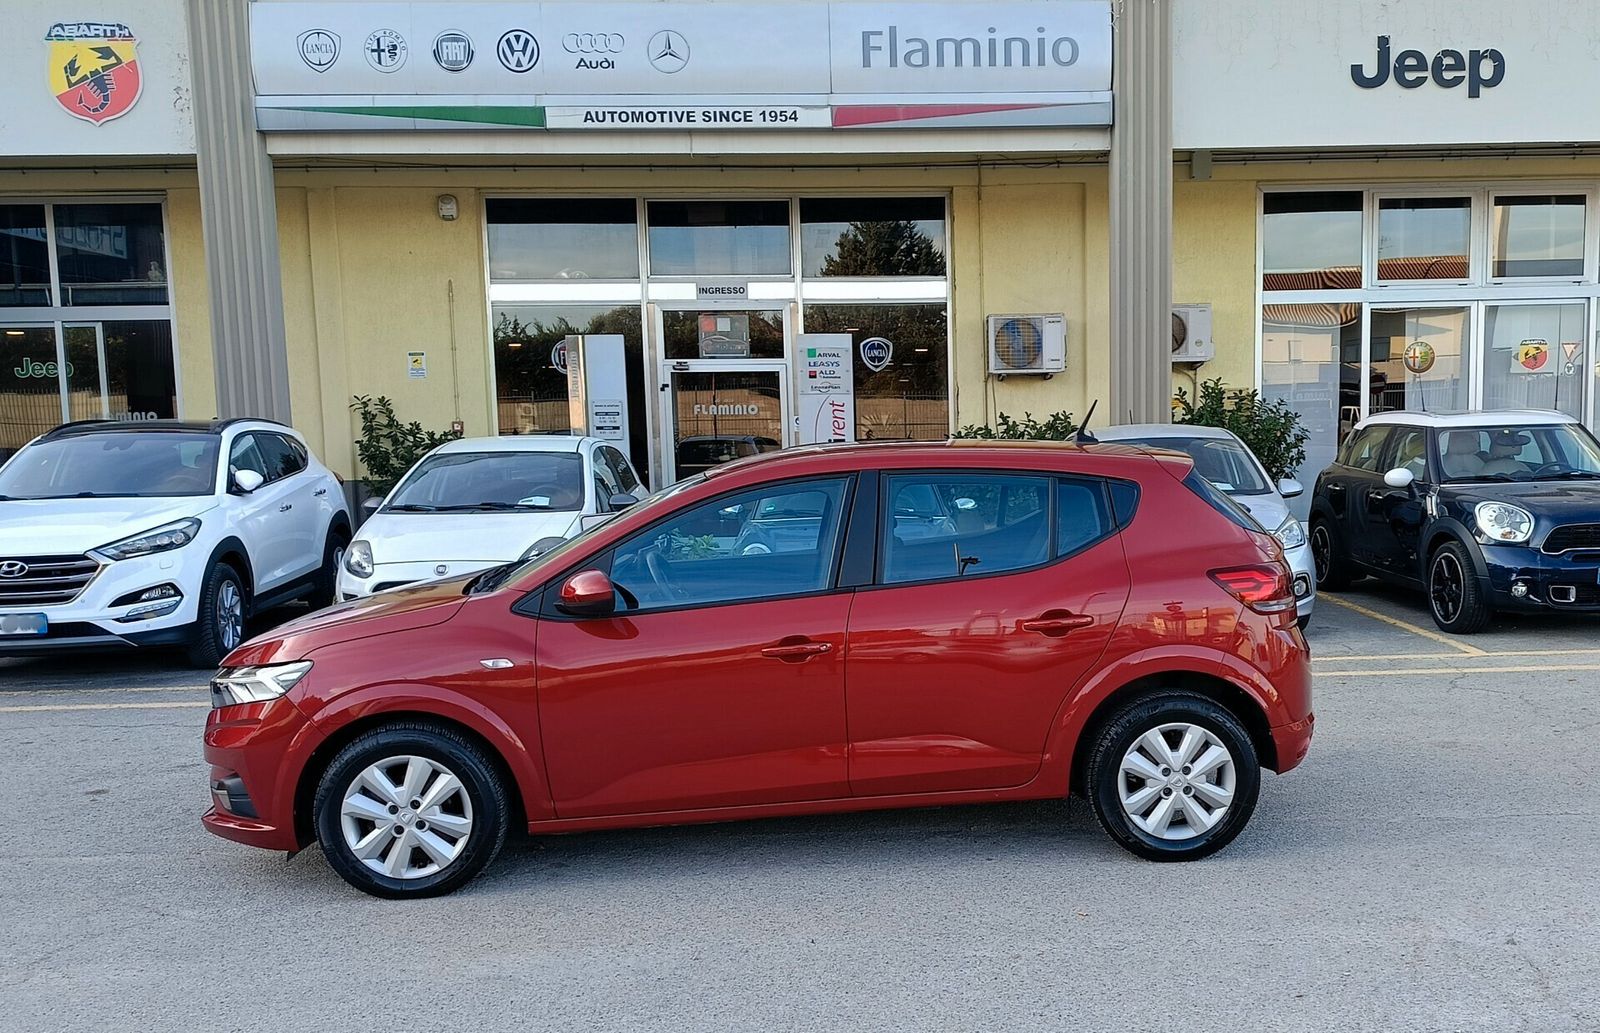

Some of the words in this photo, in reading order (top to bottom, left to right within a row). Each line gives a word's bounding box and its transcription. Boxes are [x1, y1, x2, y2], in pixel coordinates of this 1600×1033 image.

[48, 23, 133, 38] ABARTH
[305, 43, 333, 54] LANCIA
[442, 41, 466, 61] FIAT
[861, 25, 1080, 69] Flaminio
[575, 57, 615, 69] Audi
[1350, 35, 1506, 98] Jeep
[583, 110, 697, 123] AUTOMOTIVE
[701, 110, 753, 123] SINCE
[758, 110, 799, 123] 1954
[698, 286, 746, 295] INGRESSO
[693, 404, 759, 415] FLAMINIO
